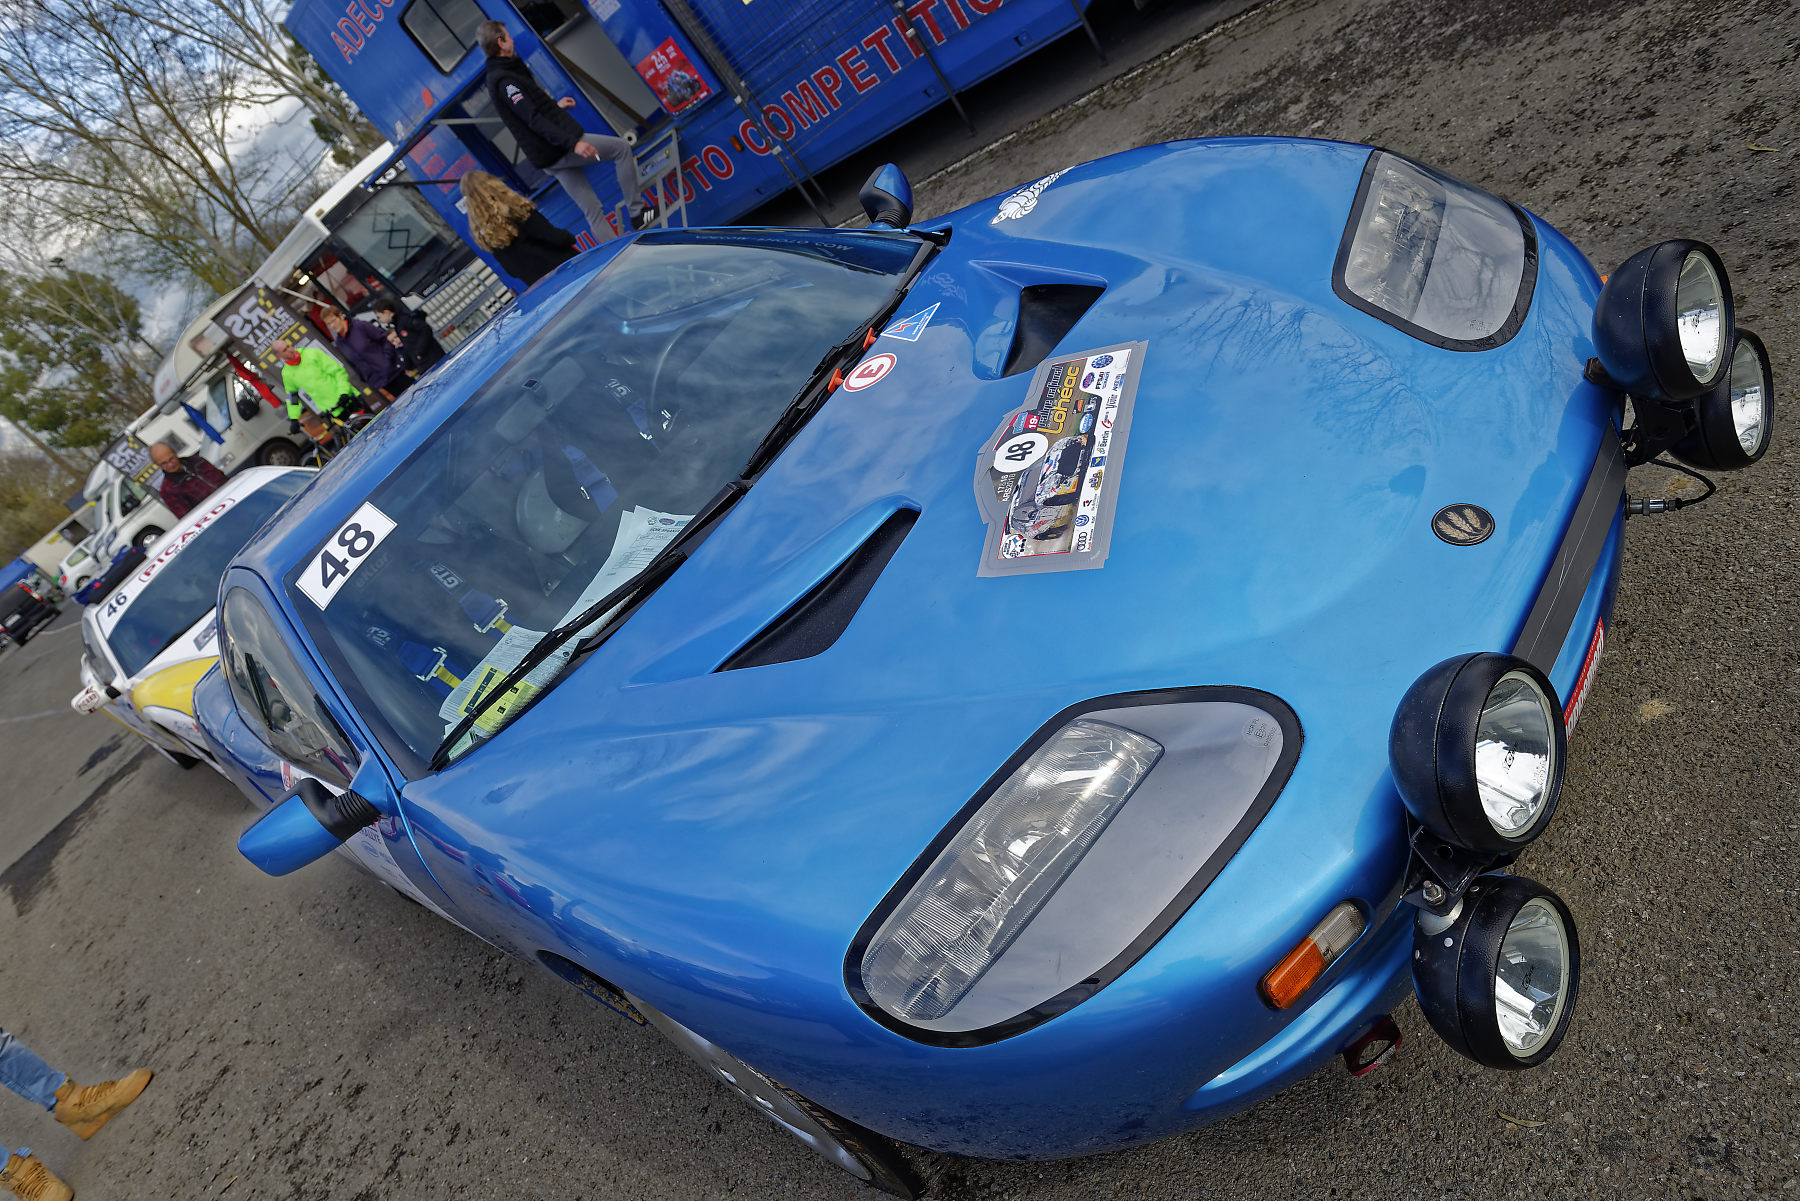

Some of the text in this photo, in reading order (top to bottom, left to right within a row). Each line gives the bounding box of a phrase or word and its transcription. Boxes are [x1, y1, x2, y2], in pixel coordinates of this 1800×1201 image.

[854, 362, 886, 379] E
[1036, 365, 1080, 434] Lohéac
[1004, 439, 1036, 462] 48
[143, 502, 227, 577] PICARD
[320, 522, 375, 589] 48
[106, 592, 128, 619] 46
